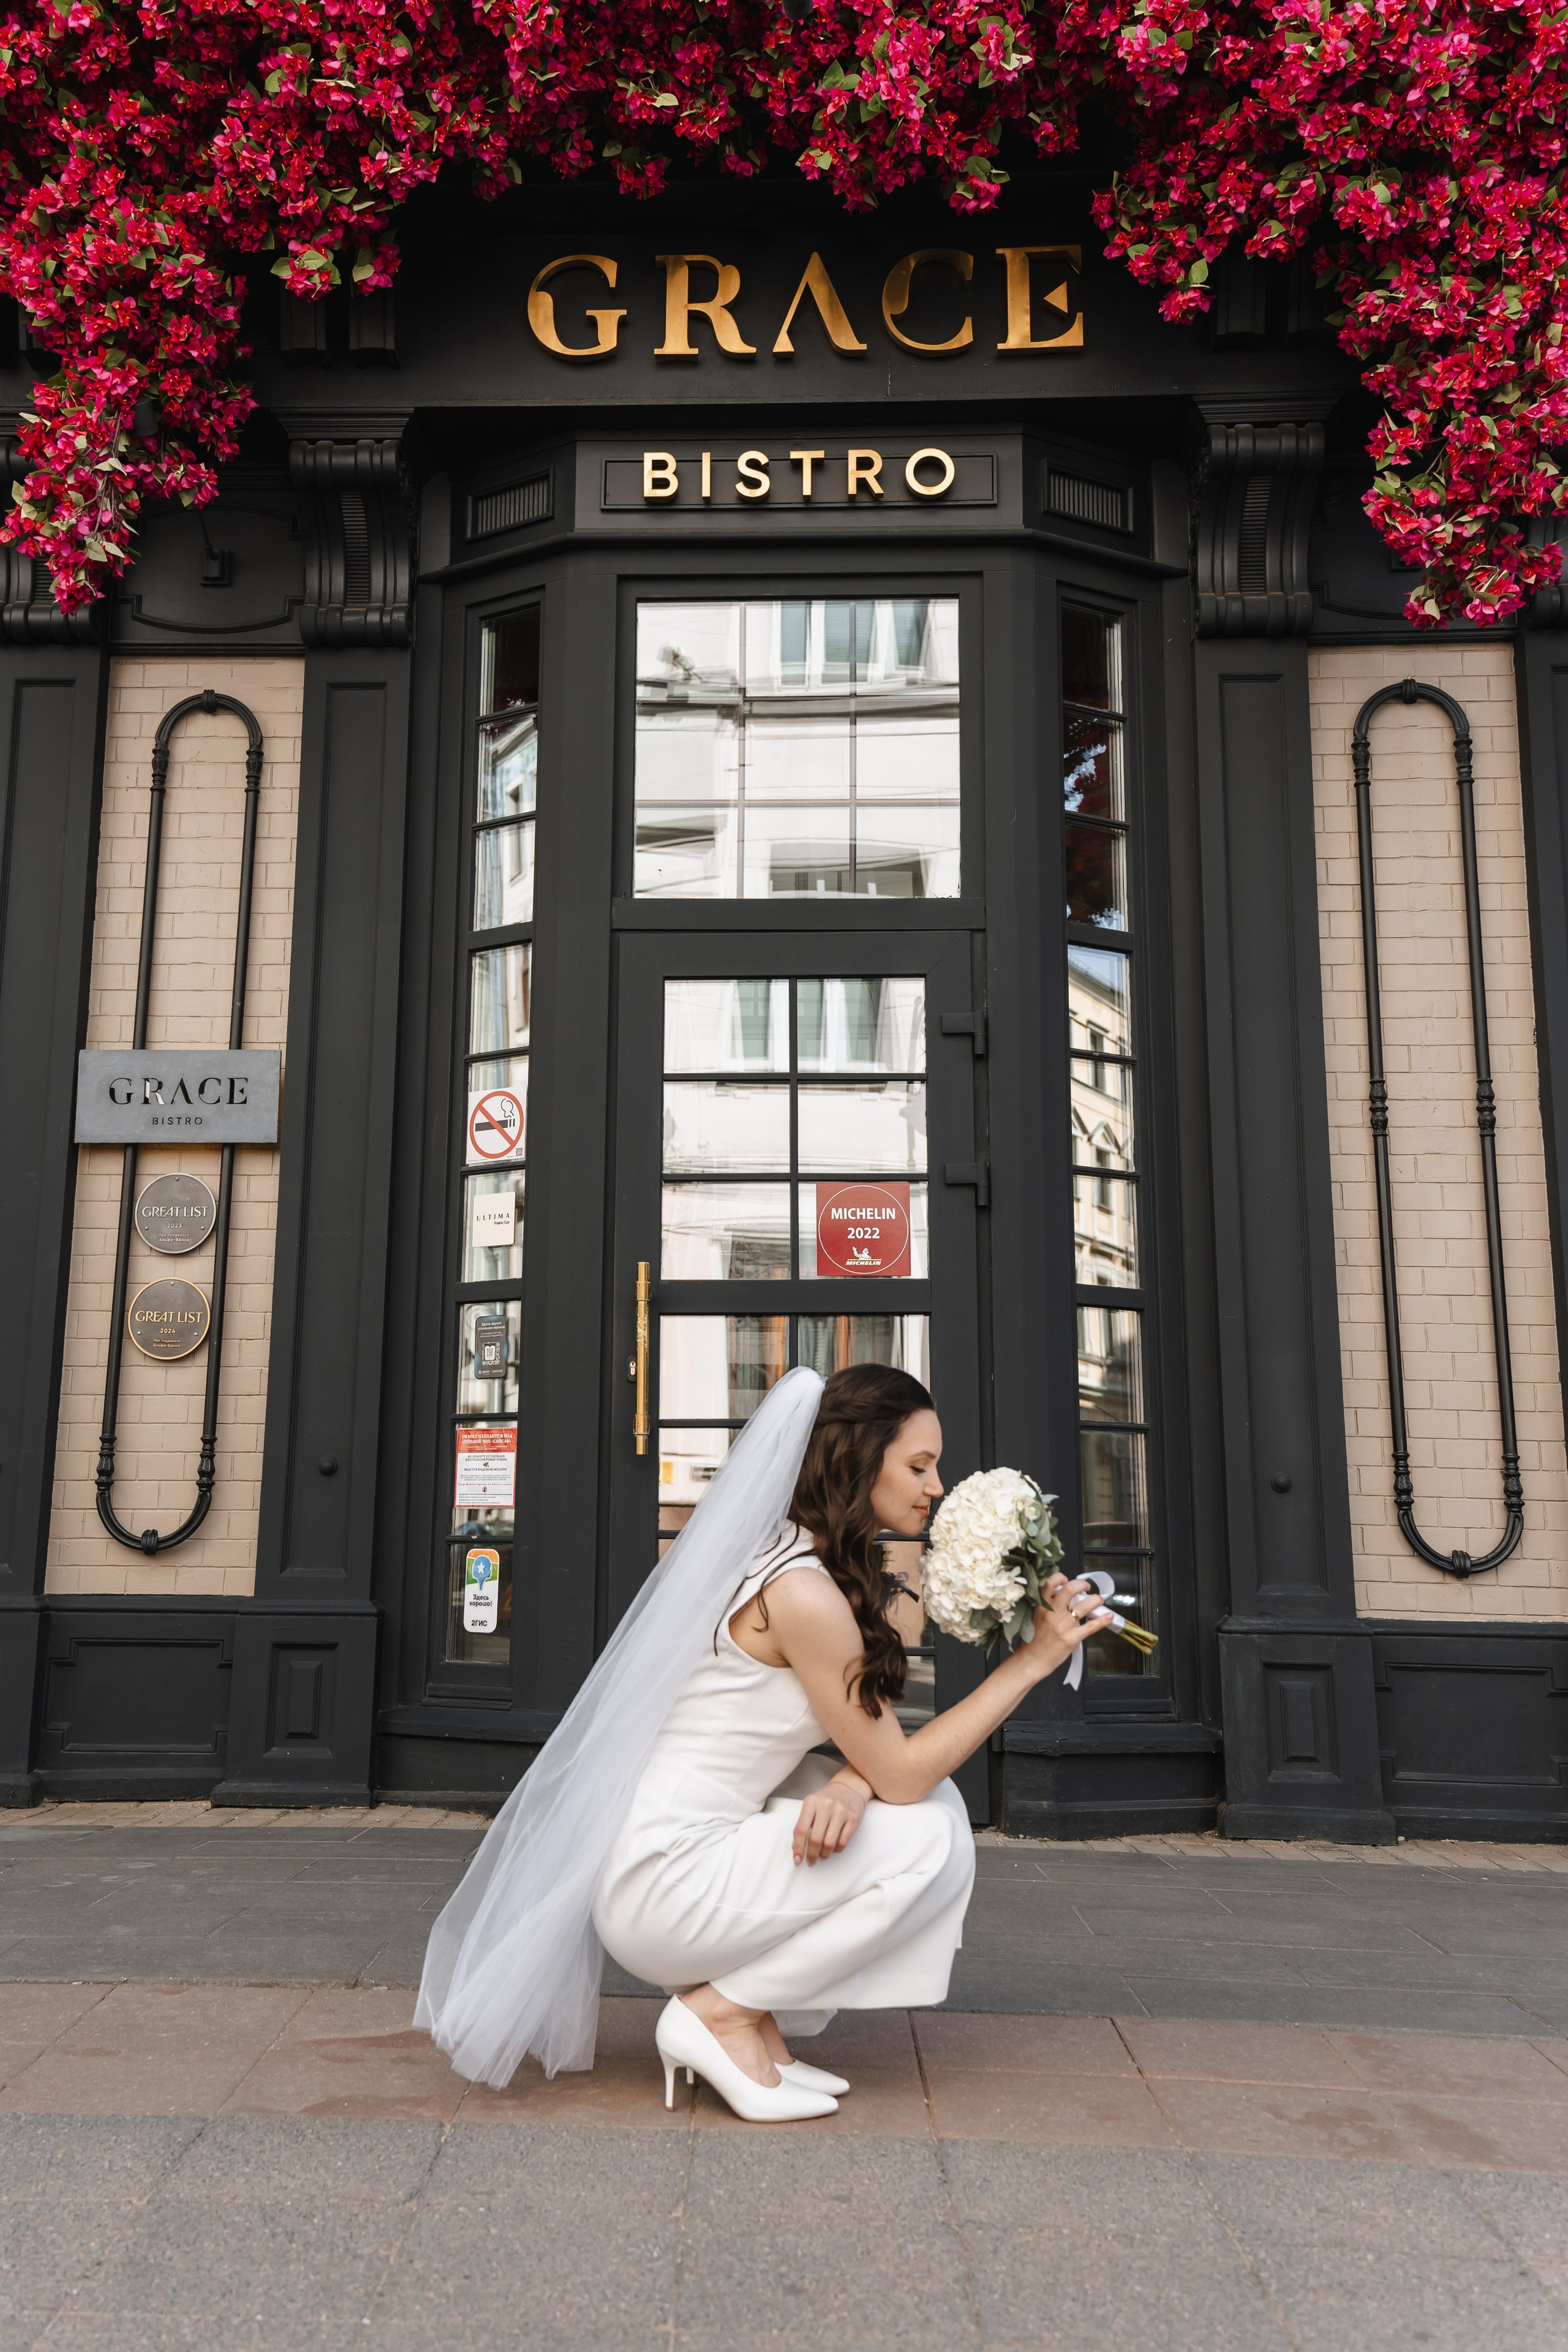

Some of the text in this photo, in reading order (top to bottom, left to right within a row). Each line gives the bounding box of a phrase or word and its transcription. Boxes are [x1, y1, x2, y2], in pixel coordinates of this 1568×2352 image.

[527, 245, 1084, 363] GRACE
[643, 448, 955, 503] BISTRO
[109, 1077, 248, 1105] GRACE
[141, 1206, 209, 1218] GREAT LIST
[831, 1208, 895, 1219] MICHELIN
[847, 1227, 880, 1239] 2022
[135, 1311, 203, 1323] GREAT LIST
